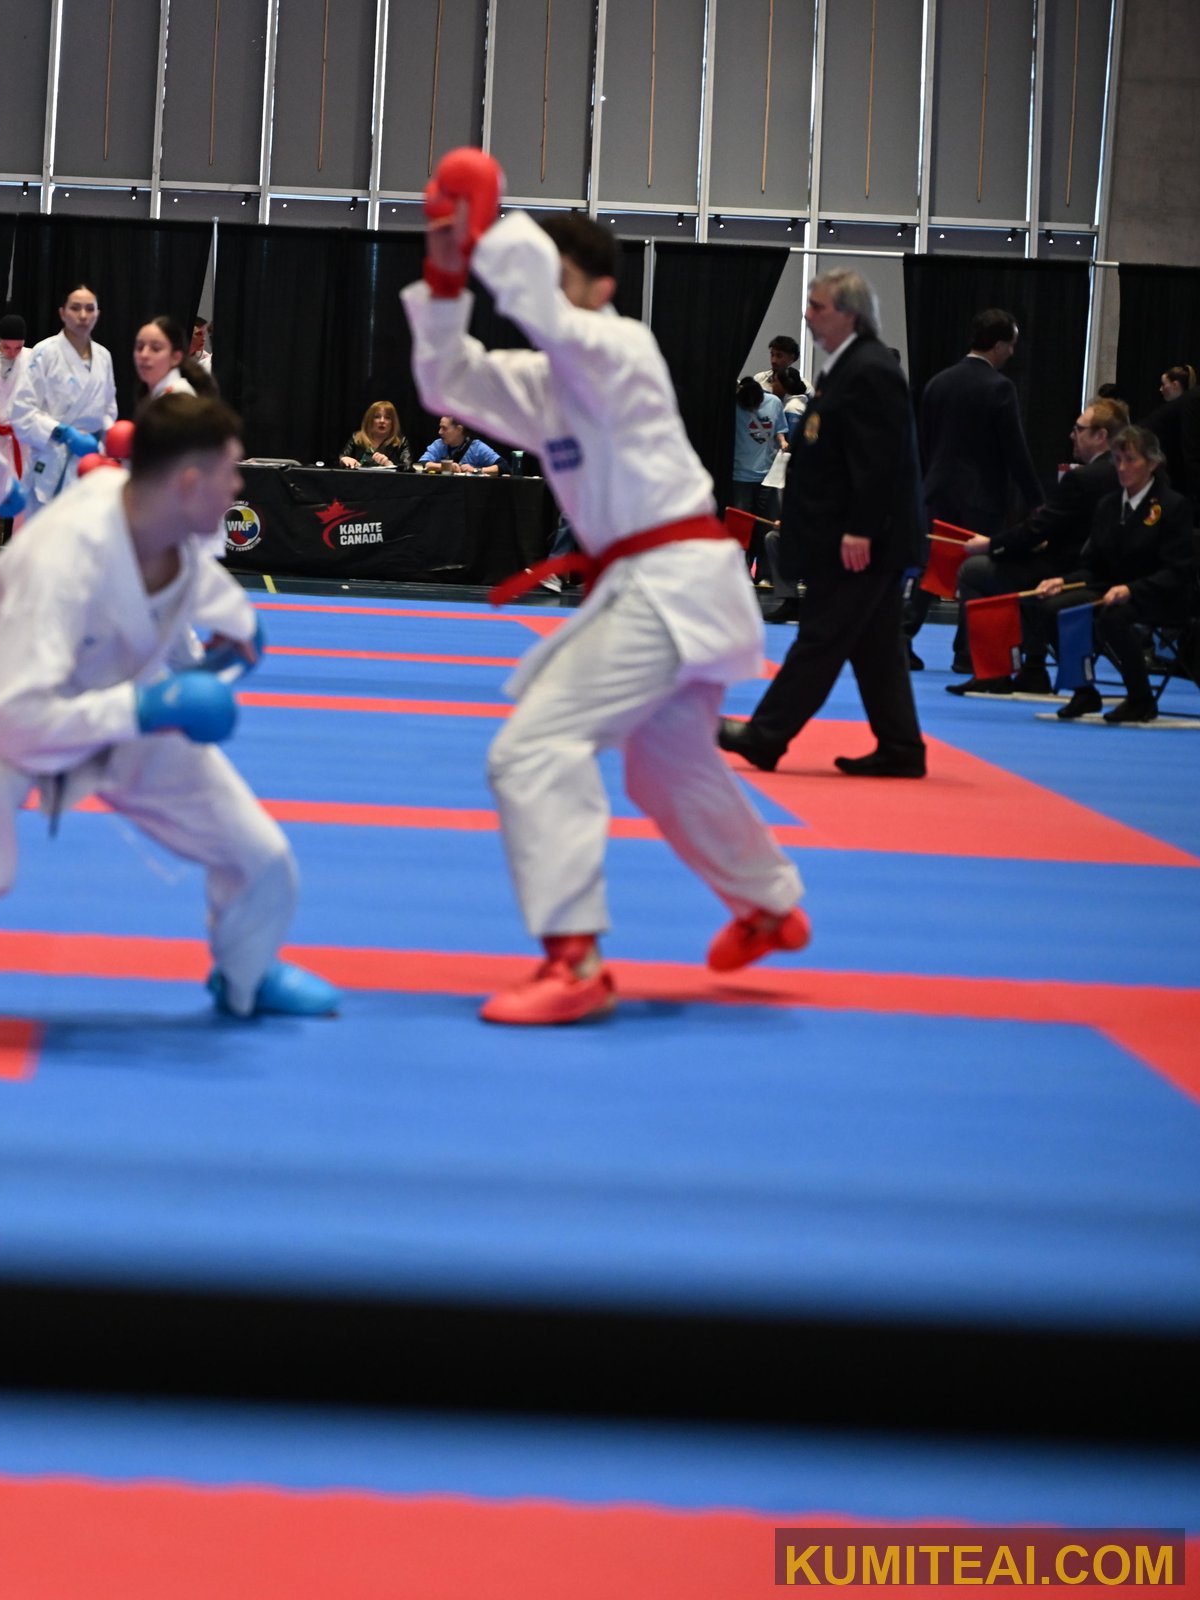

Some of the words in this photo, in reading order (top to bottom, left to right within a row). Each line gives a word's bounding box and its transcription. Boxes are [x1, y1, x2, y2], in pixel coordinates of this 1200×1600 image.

[227, 520, 253, 532] WKF
[339, 522, 382, 535] KARATE
[340, 533, 384, 546] CANADA
